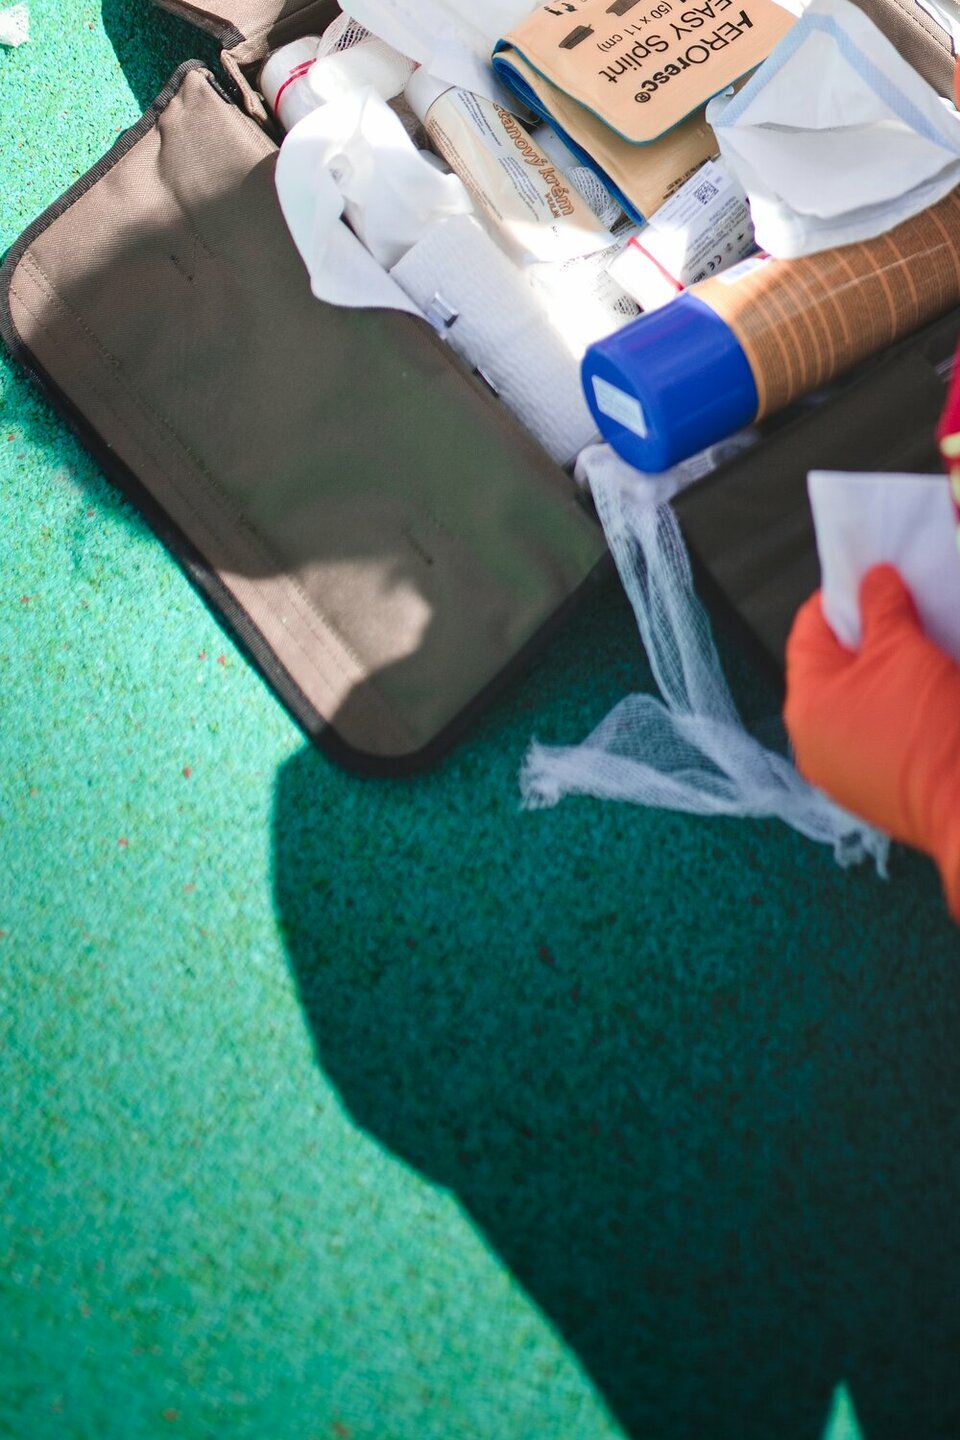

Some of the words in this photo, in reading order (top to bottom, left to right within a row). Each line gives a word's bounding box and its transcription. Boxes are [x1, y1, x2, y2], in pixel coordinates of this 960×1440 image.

[650, 0, 673, 19] (50
[639, 16, 651, 24] x
[624, 24, 642, 36] 11
[596, 33, 623, 53] cm)
[598, 34, 669, 83] Splint
[538, 167, 575, 216] krém
